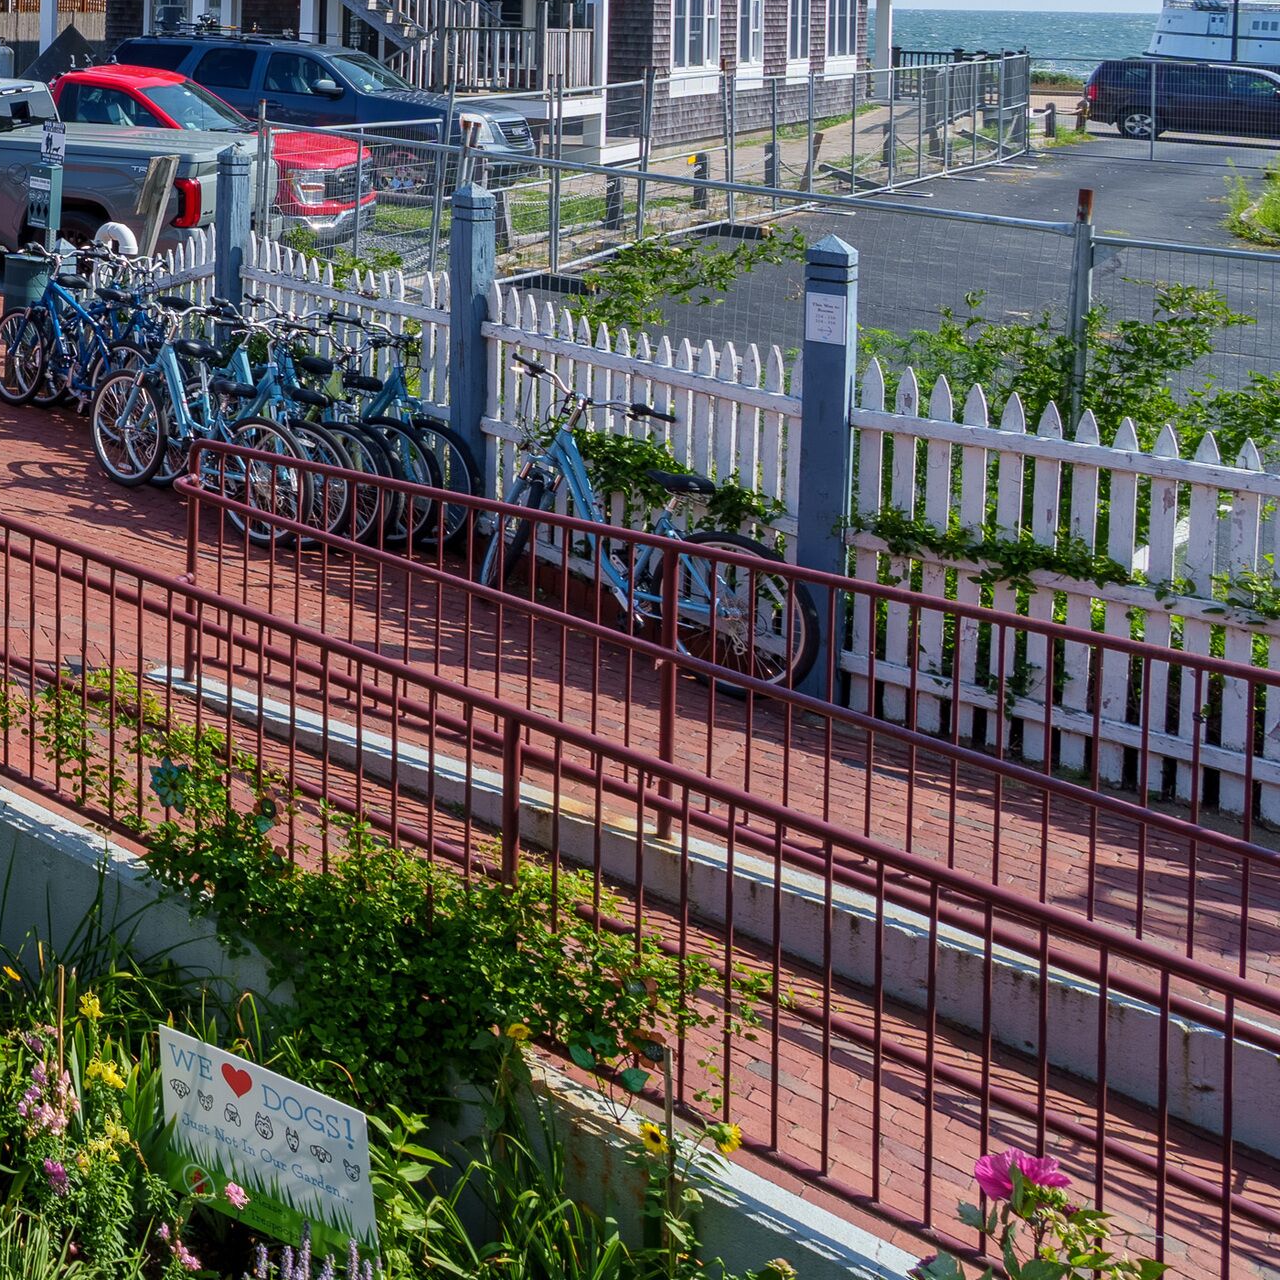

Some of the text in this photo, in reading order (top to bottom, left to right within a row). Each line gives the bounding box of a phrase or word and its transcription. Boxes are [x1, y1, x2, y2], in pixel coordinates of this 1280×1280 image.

[168, 1043, 356, 1150] WE DOGS!
[181, 1112, 210, 1135] Just
[214, 1125, 239, 1148] Not
[242, 1137, 256, 1157] In
[260, 1148, 288, 1172] Our
